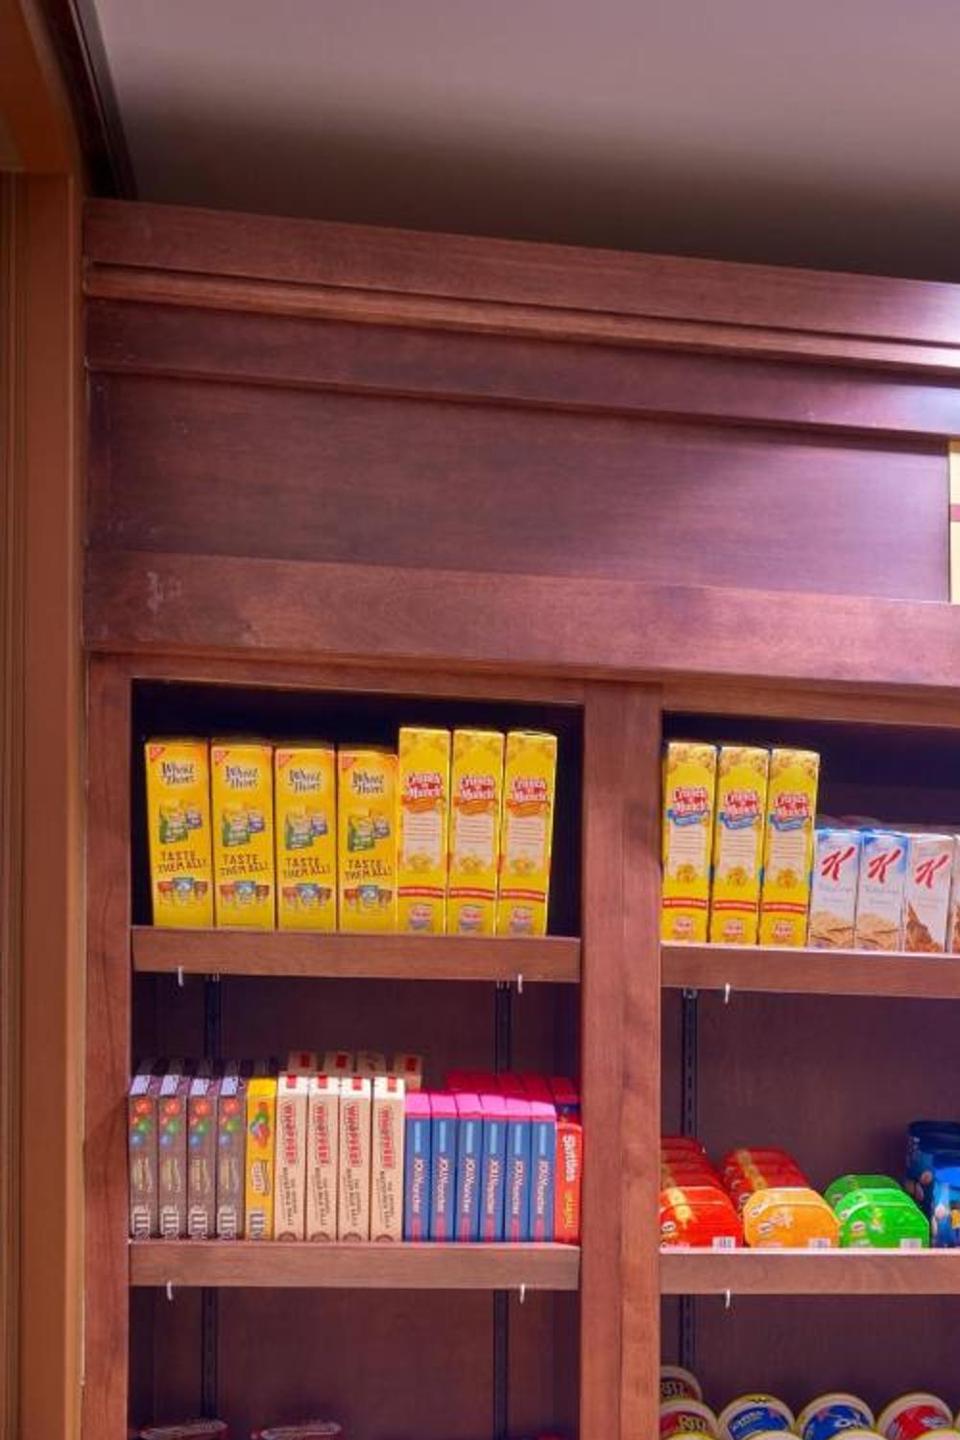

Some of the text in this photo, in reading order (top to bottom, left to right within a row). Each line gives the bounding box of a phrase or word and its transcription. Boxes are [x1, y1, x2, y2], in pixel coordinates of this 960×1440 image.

[821, 847, 855, 881] K
[868, 849, 901, 883] K
[915, 853, 949, 888] K
